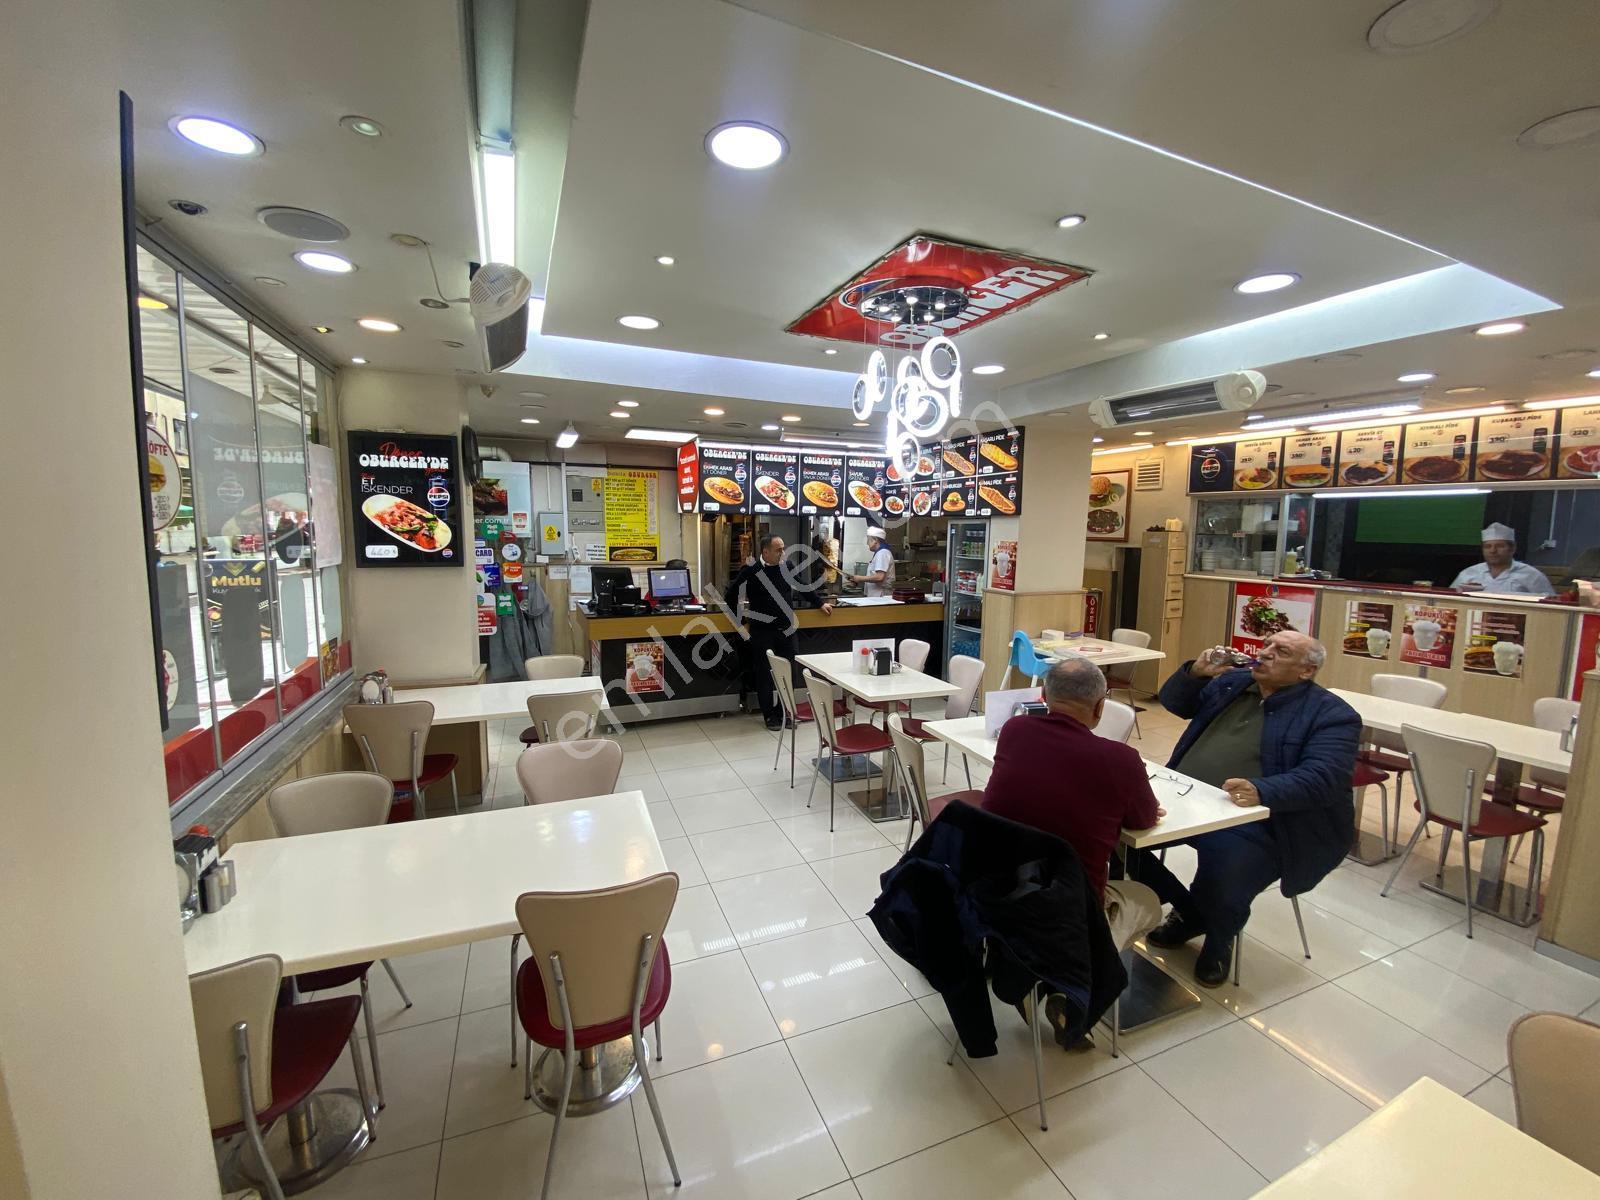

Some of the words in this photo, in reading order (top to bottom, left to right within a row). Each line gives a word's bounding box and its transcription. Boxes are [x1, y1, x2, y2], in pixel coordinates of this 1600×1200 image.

[147, 442, 168, 456] ÖFTE
[361, 477, 376, 486] ET
[475, 549, 493, 557] CARD
[211, 574, 262, 587] Mutlu
